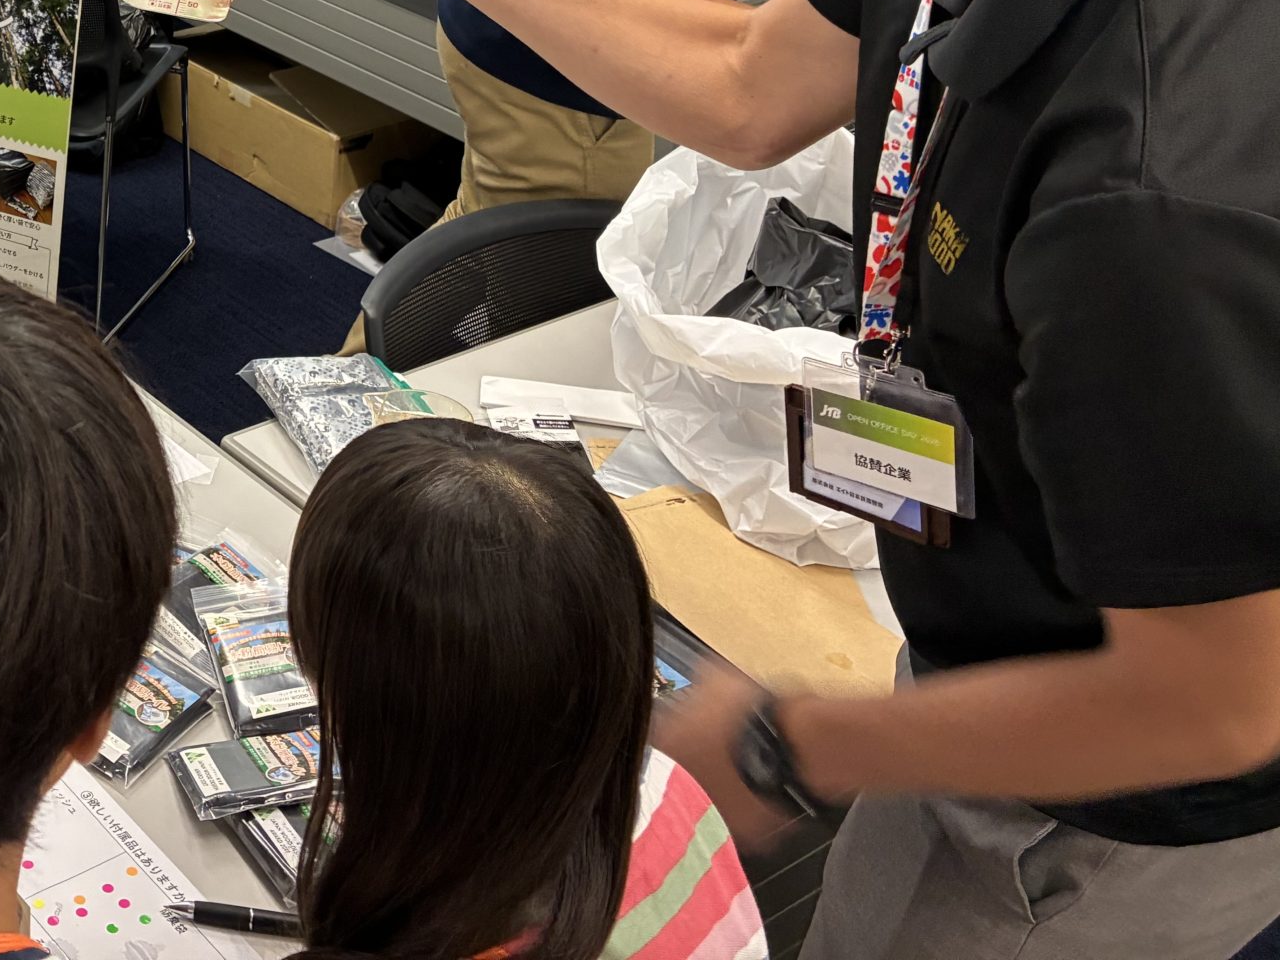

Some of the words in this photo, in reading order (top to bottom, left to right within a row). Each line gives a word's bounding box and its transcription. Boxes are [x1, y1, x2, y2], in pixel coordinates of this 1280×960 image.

[187, 1, 199, 9] 50
[820, 404, 841, 419] JTB
[847, 413, 868, 425] OPEN
[870, 420, 898, 434] OFFICE
[854, 452, 912, 483] 協賛企業
[812, 477, 834, 490] 株式会社
